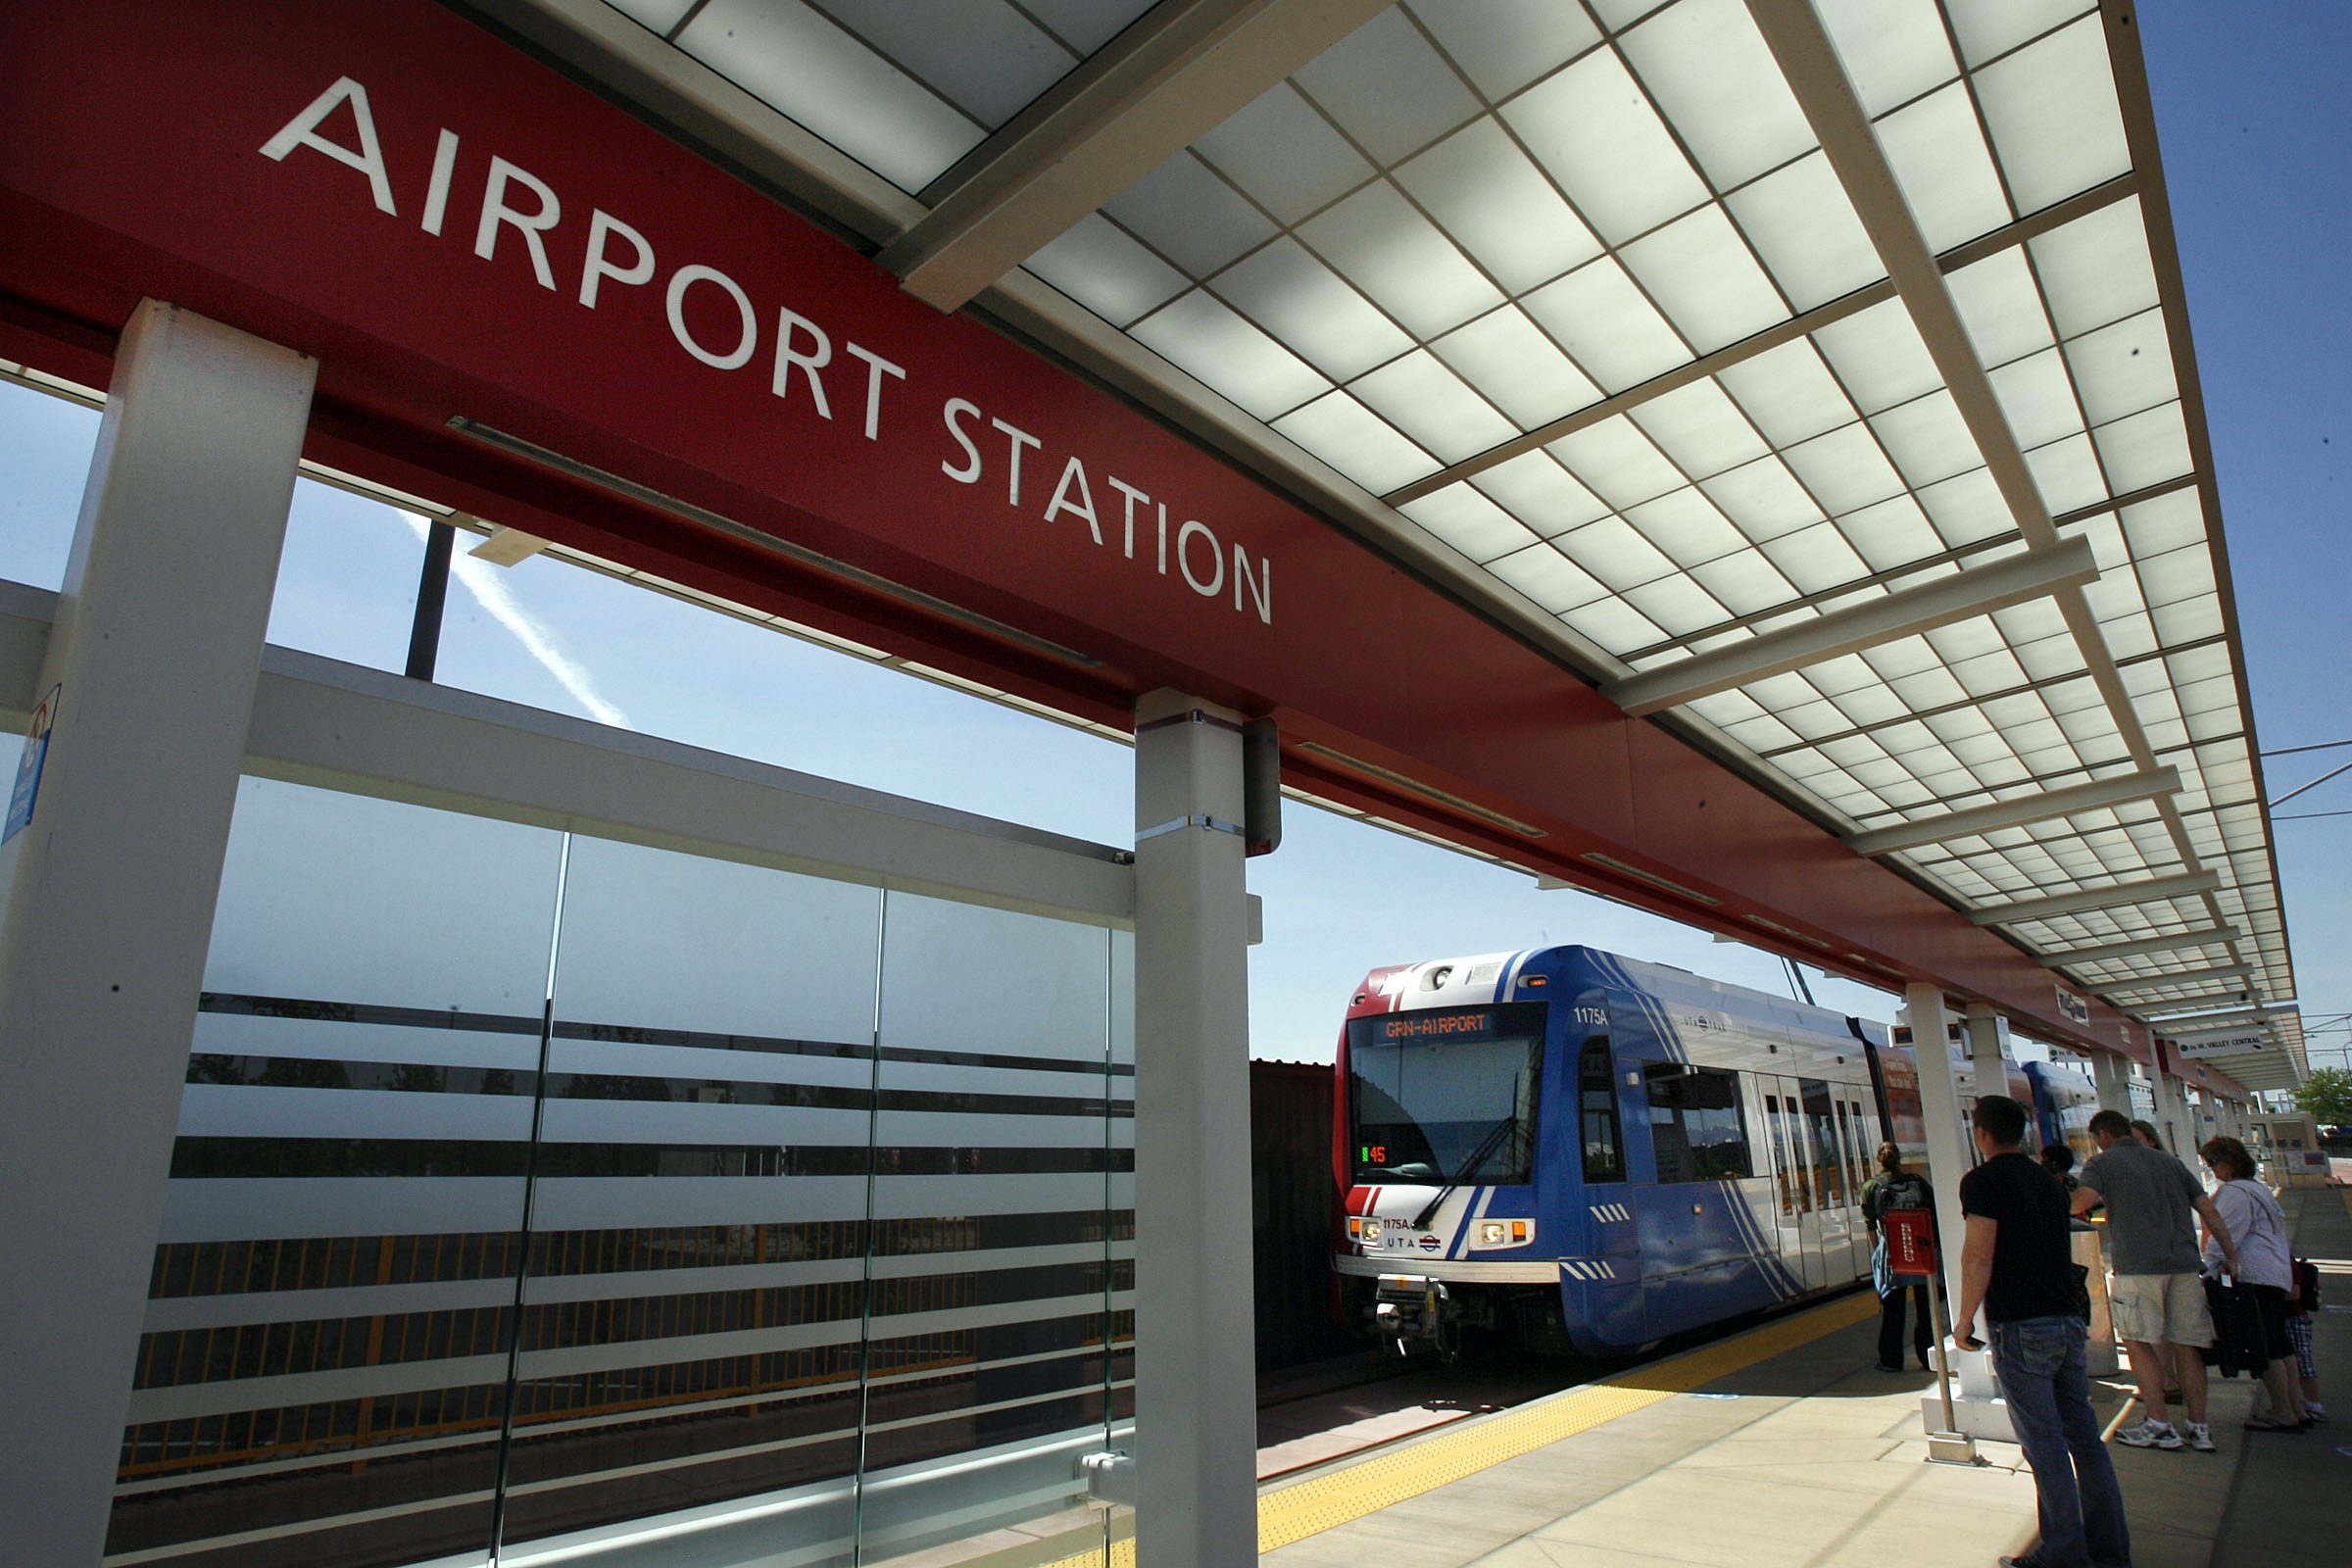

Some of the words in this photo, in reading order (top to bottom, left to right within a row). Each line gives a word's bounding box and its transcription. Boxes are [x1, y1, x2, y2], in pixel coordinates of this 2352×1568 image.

[258, 74, 906, 441] AIRPORT
[942, 397, 1272, 624] STATION
[1573, 1005, 1609, 1026] 1175A
[1386, 1013, 1486, 1038] GRN-AIRPORT
[2207, 1040, 2230, 1049] VALLEY
[2231, 1036, 2261, 1046] CENTRAL
[1383, 1218, 1410, 1230] 1175A
[1388, 1238, 1415, 1248] UTA
